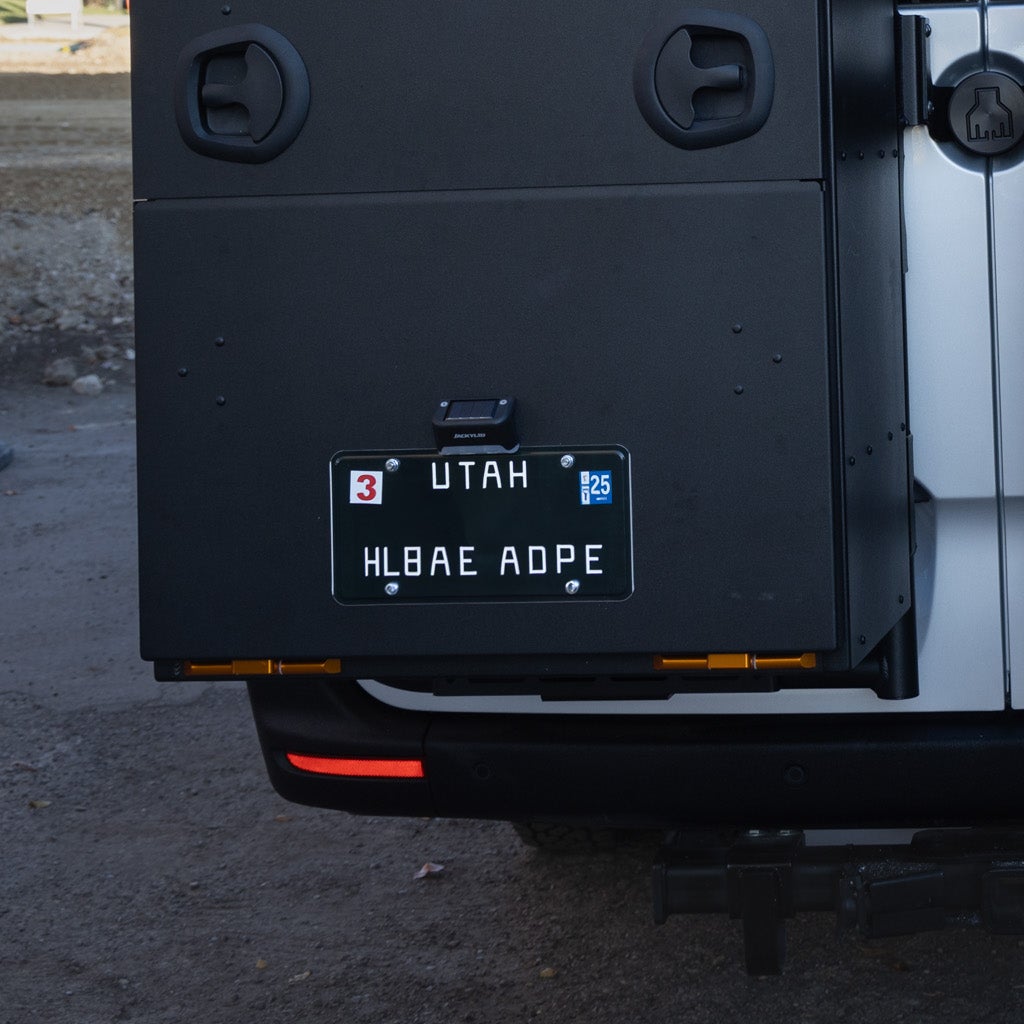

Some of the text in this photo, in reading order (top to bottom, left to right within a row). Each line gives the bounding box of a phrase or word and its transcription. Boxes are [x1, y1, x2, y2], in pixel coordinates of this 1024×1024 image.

[356, 474, 377, 501] 3
[431, 460, 528, 490] UTAH
[590, 474, 611, 495] 25
[500, 544, 603, 576] ADPE
